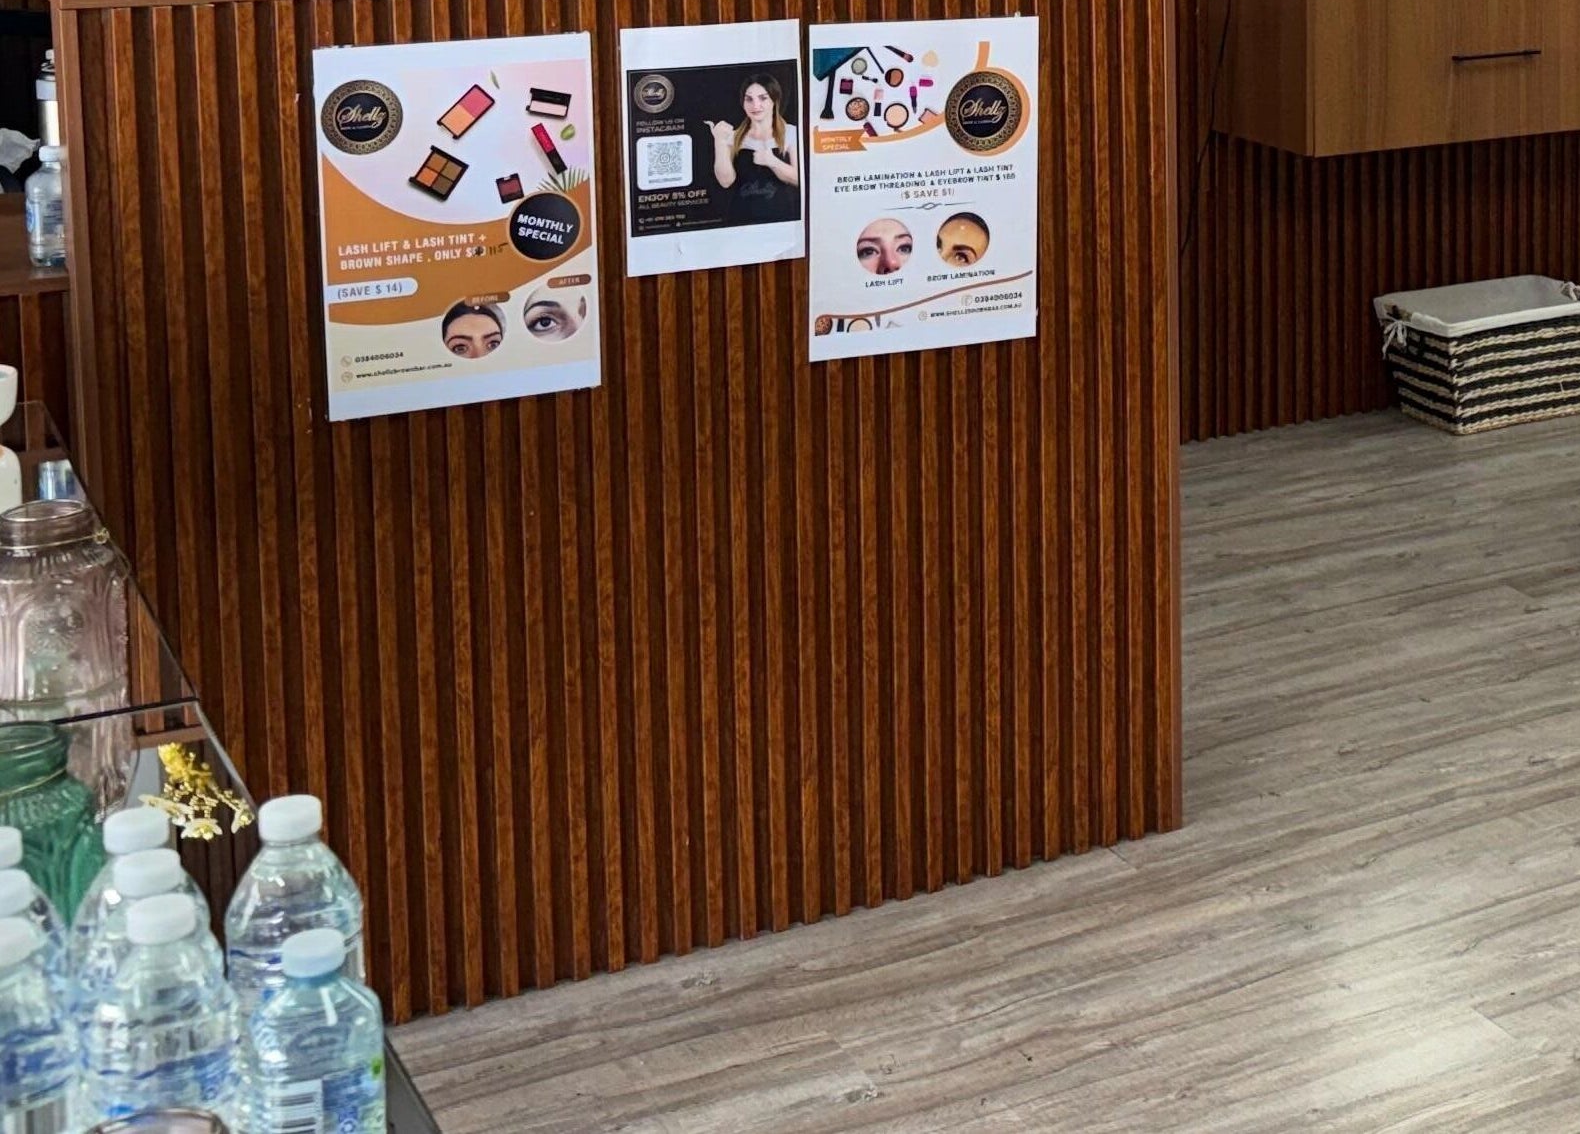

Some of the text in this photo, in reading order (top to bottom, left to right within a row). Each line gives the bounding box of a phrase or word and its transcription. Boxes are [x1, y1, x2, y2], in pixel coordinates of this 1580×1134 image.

[636, 119, 663, 127] FOLLOW
[636, 124, 685, 133] INSTAGRAM
[820, 136, 852, 144] MONTHLY
[837, 175, 861, 184] BROW
[863, 171, 915, 182] LAMINATION
[925, 169, 946, 178] LASH
[948, 167, 965, 176] LIFT
[974, 166, 995, 174] LASH
[997, 164, 1014, 172] TINT
[834, 185, 850, 193] EYE
[852, 183, 876, 192] BROW
[879, 180, 926, 190] THREADING
[938, 177, 974, 186] EYEBROW
[977, 174, 994, 182] TINT
[638, 194, 670, 203] ENJOY
[913, 188, 939, 199] SAVE
[517, 214, 574, 233] MONTHLY
[518, 227, 564, 245] SPECIAL
[338, 233, 487, 256] LASH LIFT & LASH TINT +
[340, 257, 382, 270] BROWN
[386, 254, 423, 266] SHAPE
[434, 248, 461, 261] ONLY
[559, 277, 580, 285] AFTER
[927, 269, 996, 282] BROW LAMINATION
[865, 278, 903, 288] LASH LIFT
[337, 284, 371, 299] (SAVE
[375, 284, 382, 295] $
[472, 294, 498, 303] BEFORE
